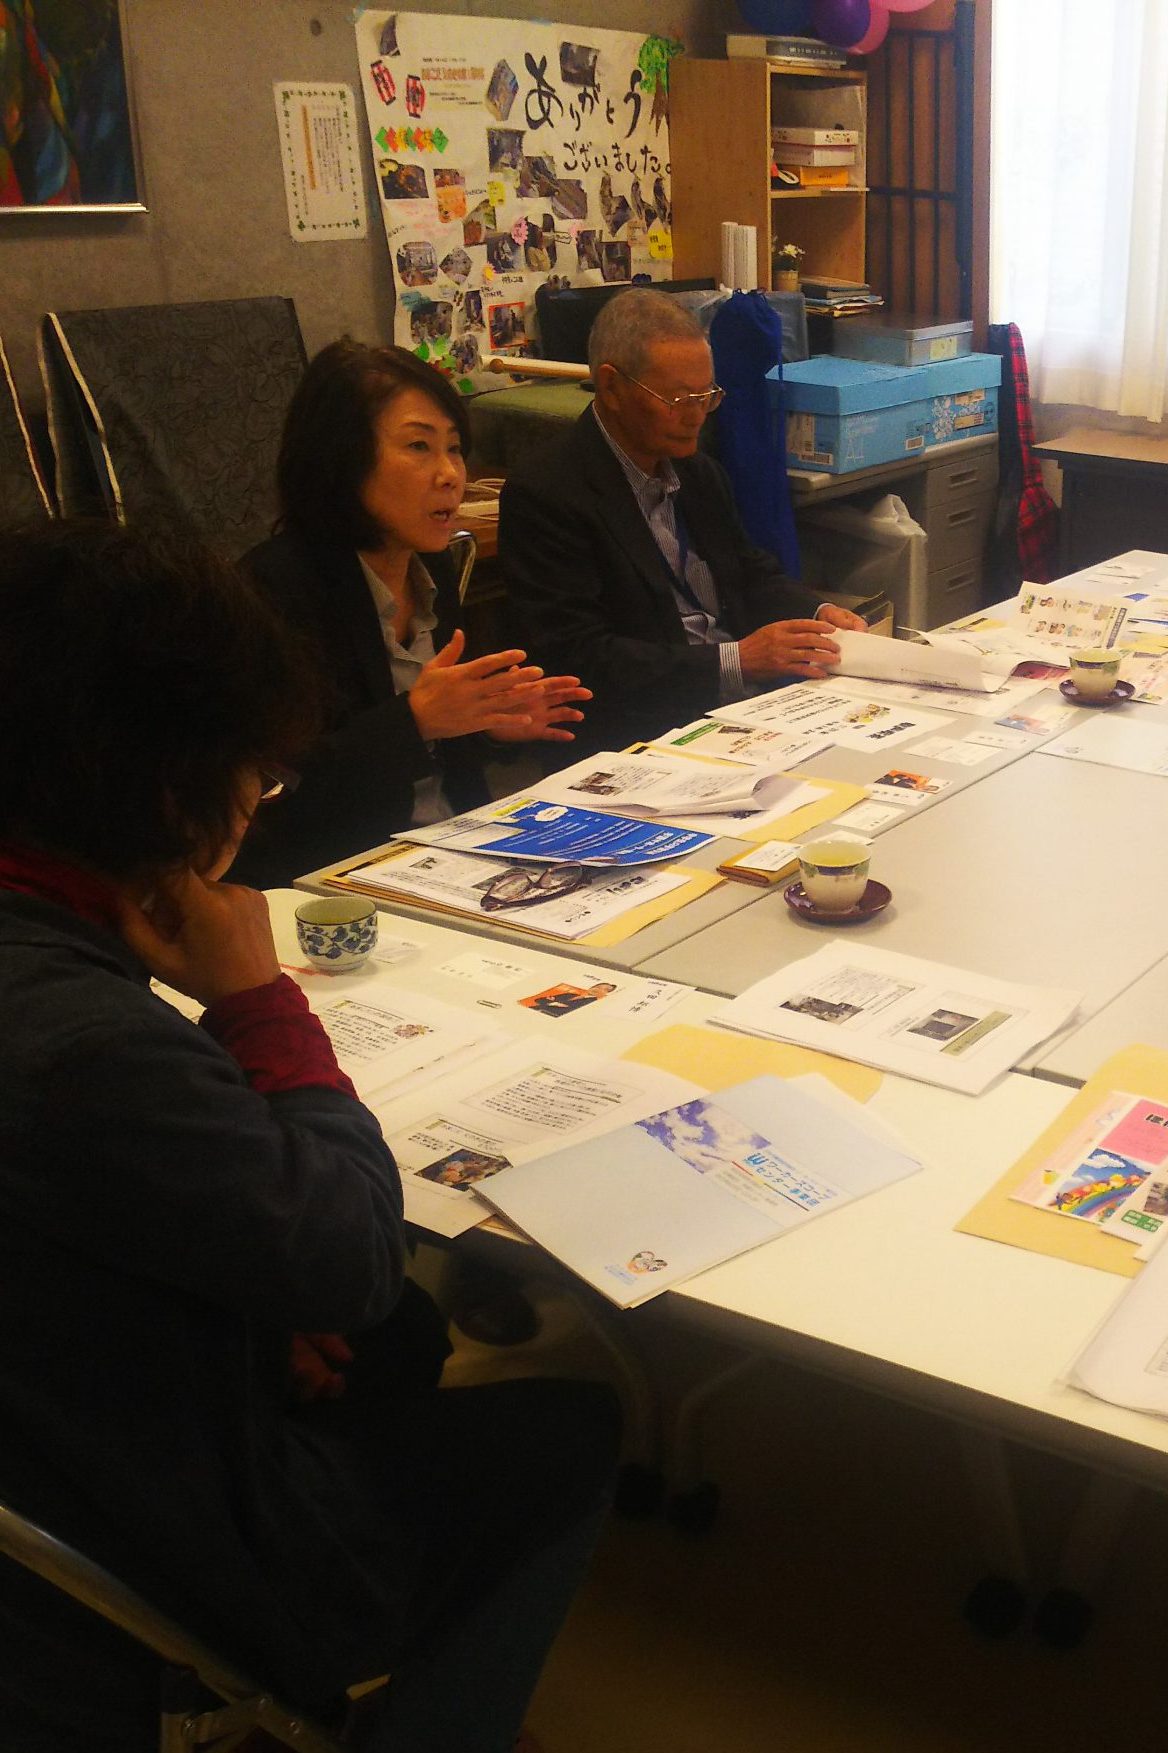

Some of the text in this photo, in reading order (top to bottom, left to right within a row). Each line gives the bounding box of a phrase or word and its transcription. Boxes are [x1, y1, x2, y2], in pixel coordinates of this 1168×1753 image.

[524, 52, 642, 139] ありがとう
